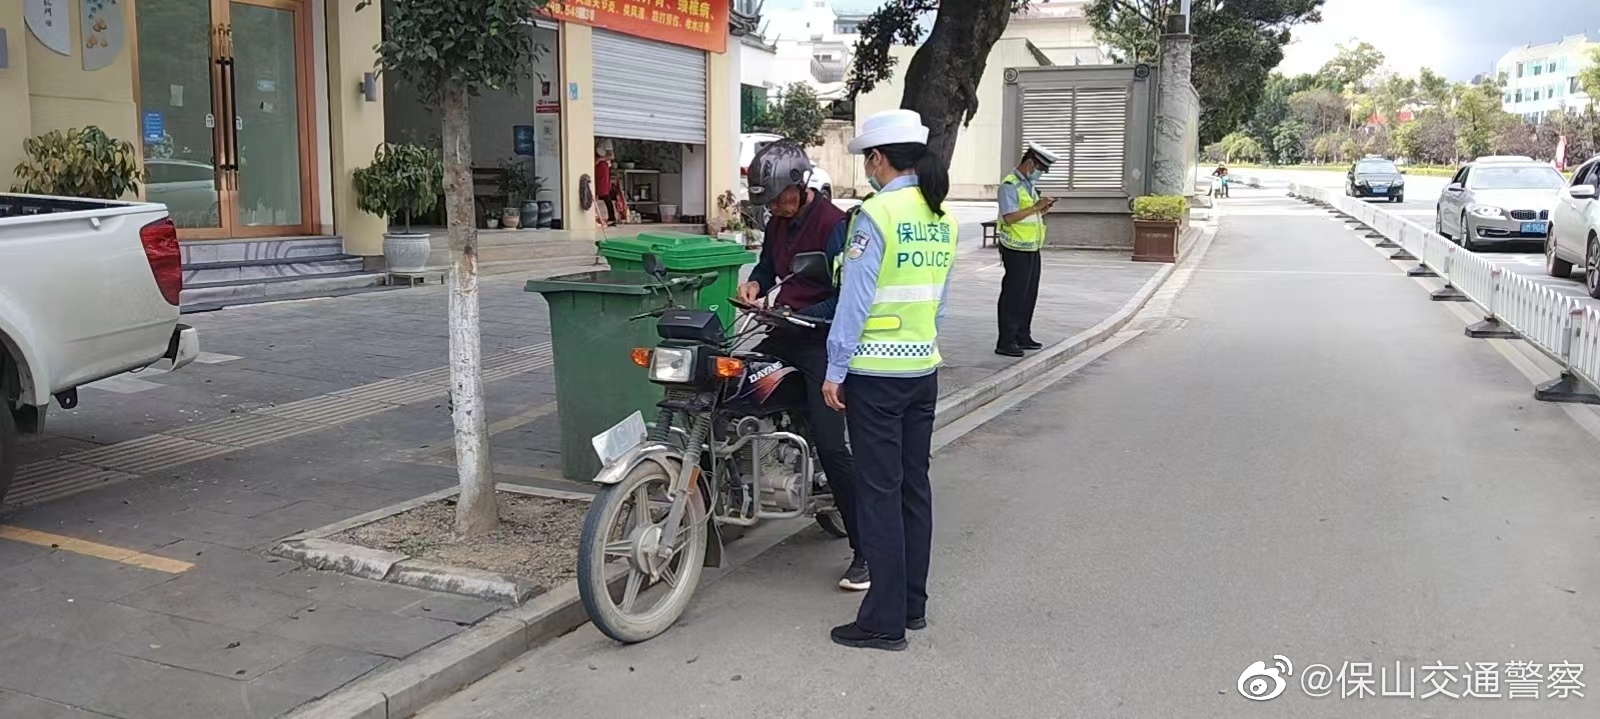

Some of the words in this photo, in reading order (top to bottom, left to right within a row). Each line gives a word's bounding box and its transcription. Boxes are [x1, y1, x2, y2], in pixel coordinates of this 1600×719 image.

[896, 221, 951, 244] 保山交警
[897, 250, 951, 268] POLICE
